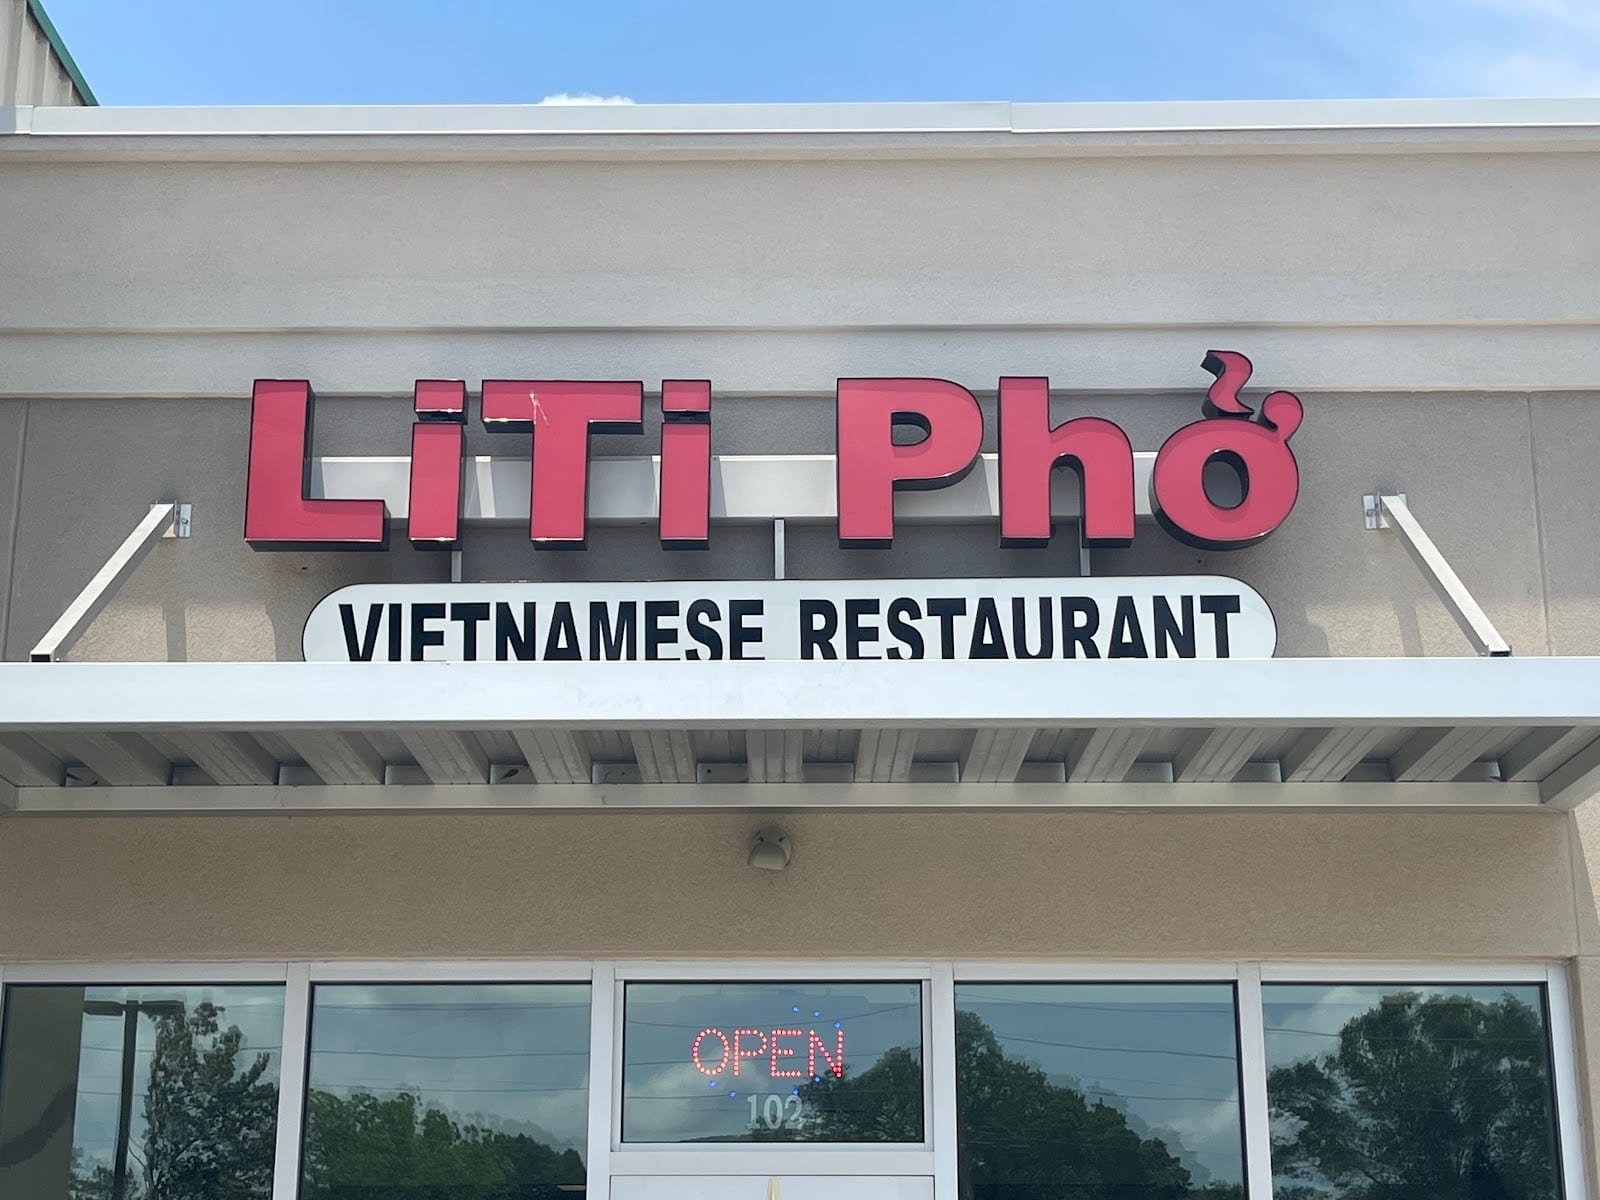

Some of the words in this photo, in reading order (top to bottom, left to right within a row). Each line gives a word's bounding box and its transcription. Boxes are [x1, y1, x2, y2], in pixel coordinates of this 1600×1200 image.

[245, 379, 711, 549] LiTi
[339, 599, 765, 661] VIETNAMESE
[800, 594, 1241, 659] RESTAURANT
[692, 1027, 844, 1078] OPEN
[746, 1094, 803, 1130] 102
